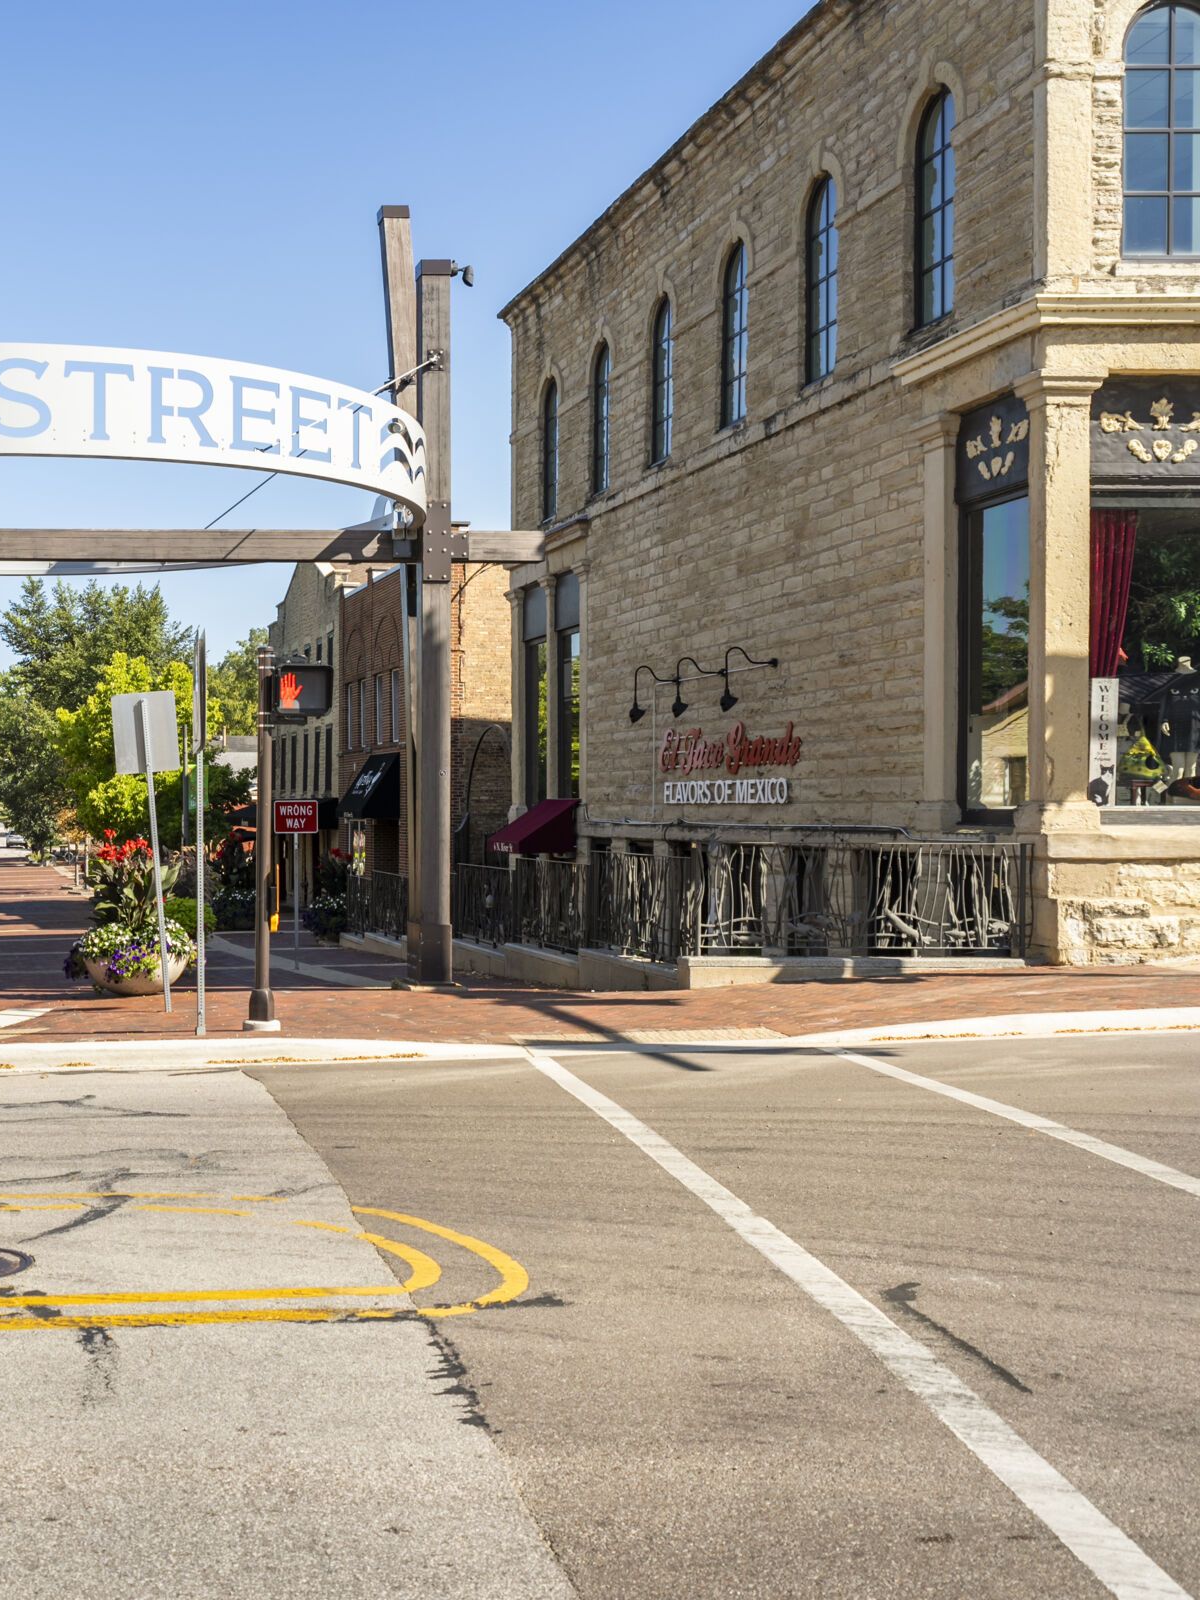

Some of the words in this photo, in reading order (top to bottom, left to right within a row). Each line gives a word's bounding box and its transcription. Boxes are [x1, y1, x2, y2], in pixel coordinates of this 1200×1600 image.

[1098, 685, 1110, 750] WELCOME
[660, 728, 680, 773] El
[663, 781, 711, 804] FLAVORS
[714, 780, 732, 804] OF
[736, 778, 788, 804] MEXICO
[279, 805, 313, 816] WRONG
[285, 818, 306, 829] WAY
